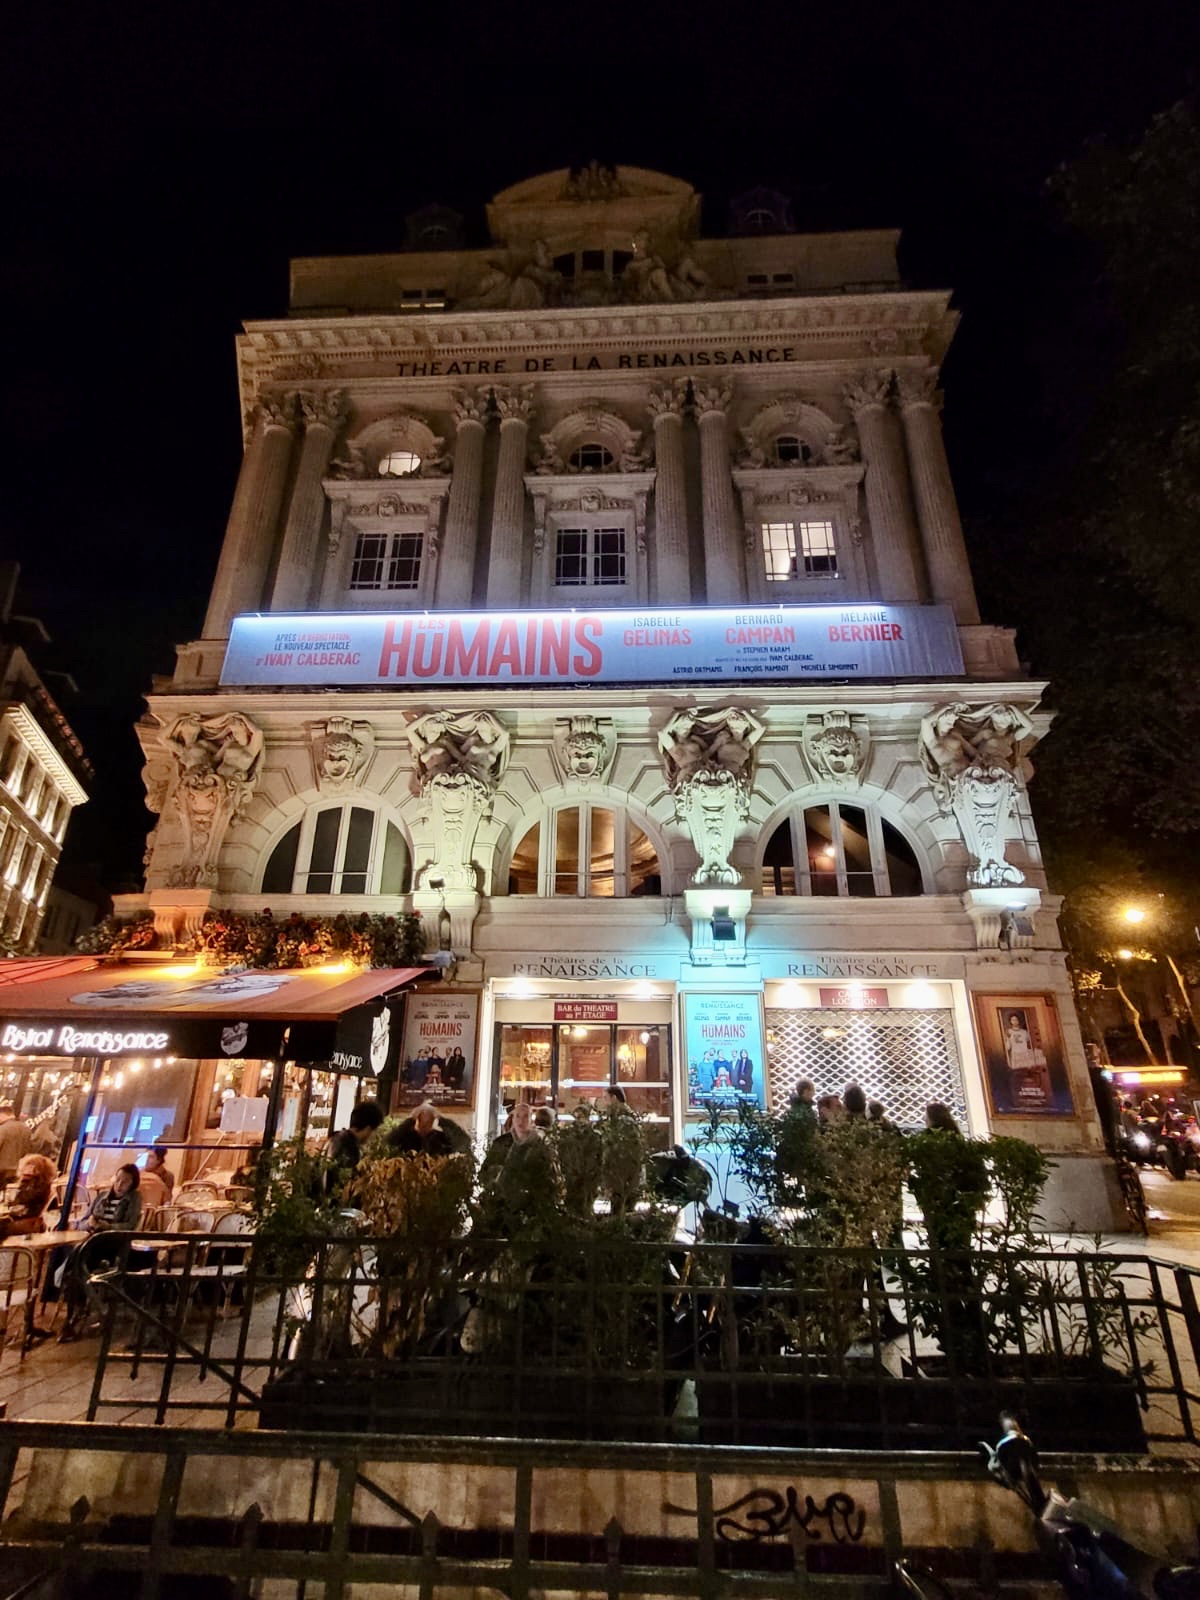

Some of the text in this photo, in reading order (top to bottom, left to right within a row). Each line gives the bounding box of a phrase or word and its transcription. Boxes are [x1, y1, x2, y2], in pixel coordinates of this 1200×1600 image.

[396, 348, 797, 377] THEATRE DE LA RENAISSANCE
[418, 619, 445, 629] LES
[633, 617, 681, 627] ISABELLE
[735, 614, 783, 625] BERNARD
[725, 626, 796, 644] CAMPAN
[828, 623, 904, 642] BERNIER
[284, 641, 313, 650] NOUVEAU
[314, 641, 350, 650] SPECTACLE
[512, 963, 656, 977] RENAISSANCE
[788, 964, 939, 977] RENAISSANCE
[57, 1026, 169, 1053] Renaissance
